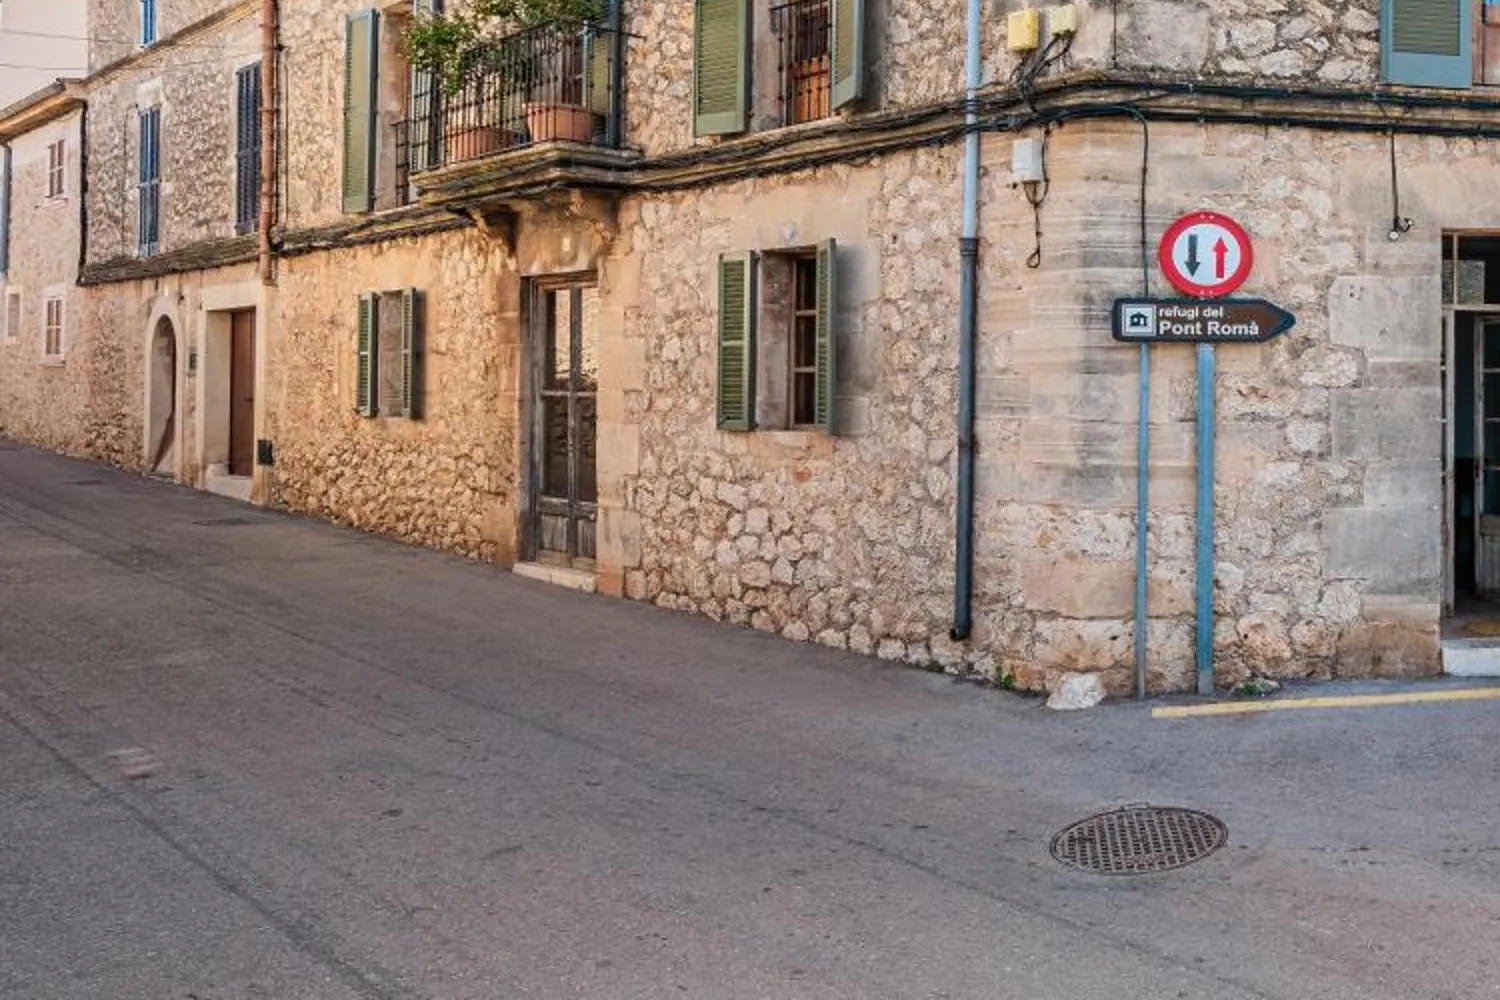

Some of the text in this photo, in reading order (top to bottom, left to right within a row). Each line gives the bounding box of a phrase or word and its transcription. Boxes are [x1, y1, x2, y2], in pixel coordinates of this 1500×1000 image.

[1158, 305, 1224, 318] refugi del
[1158, 321, 1259, 336] Pont Romà
